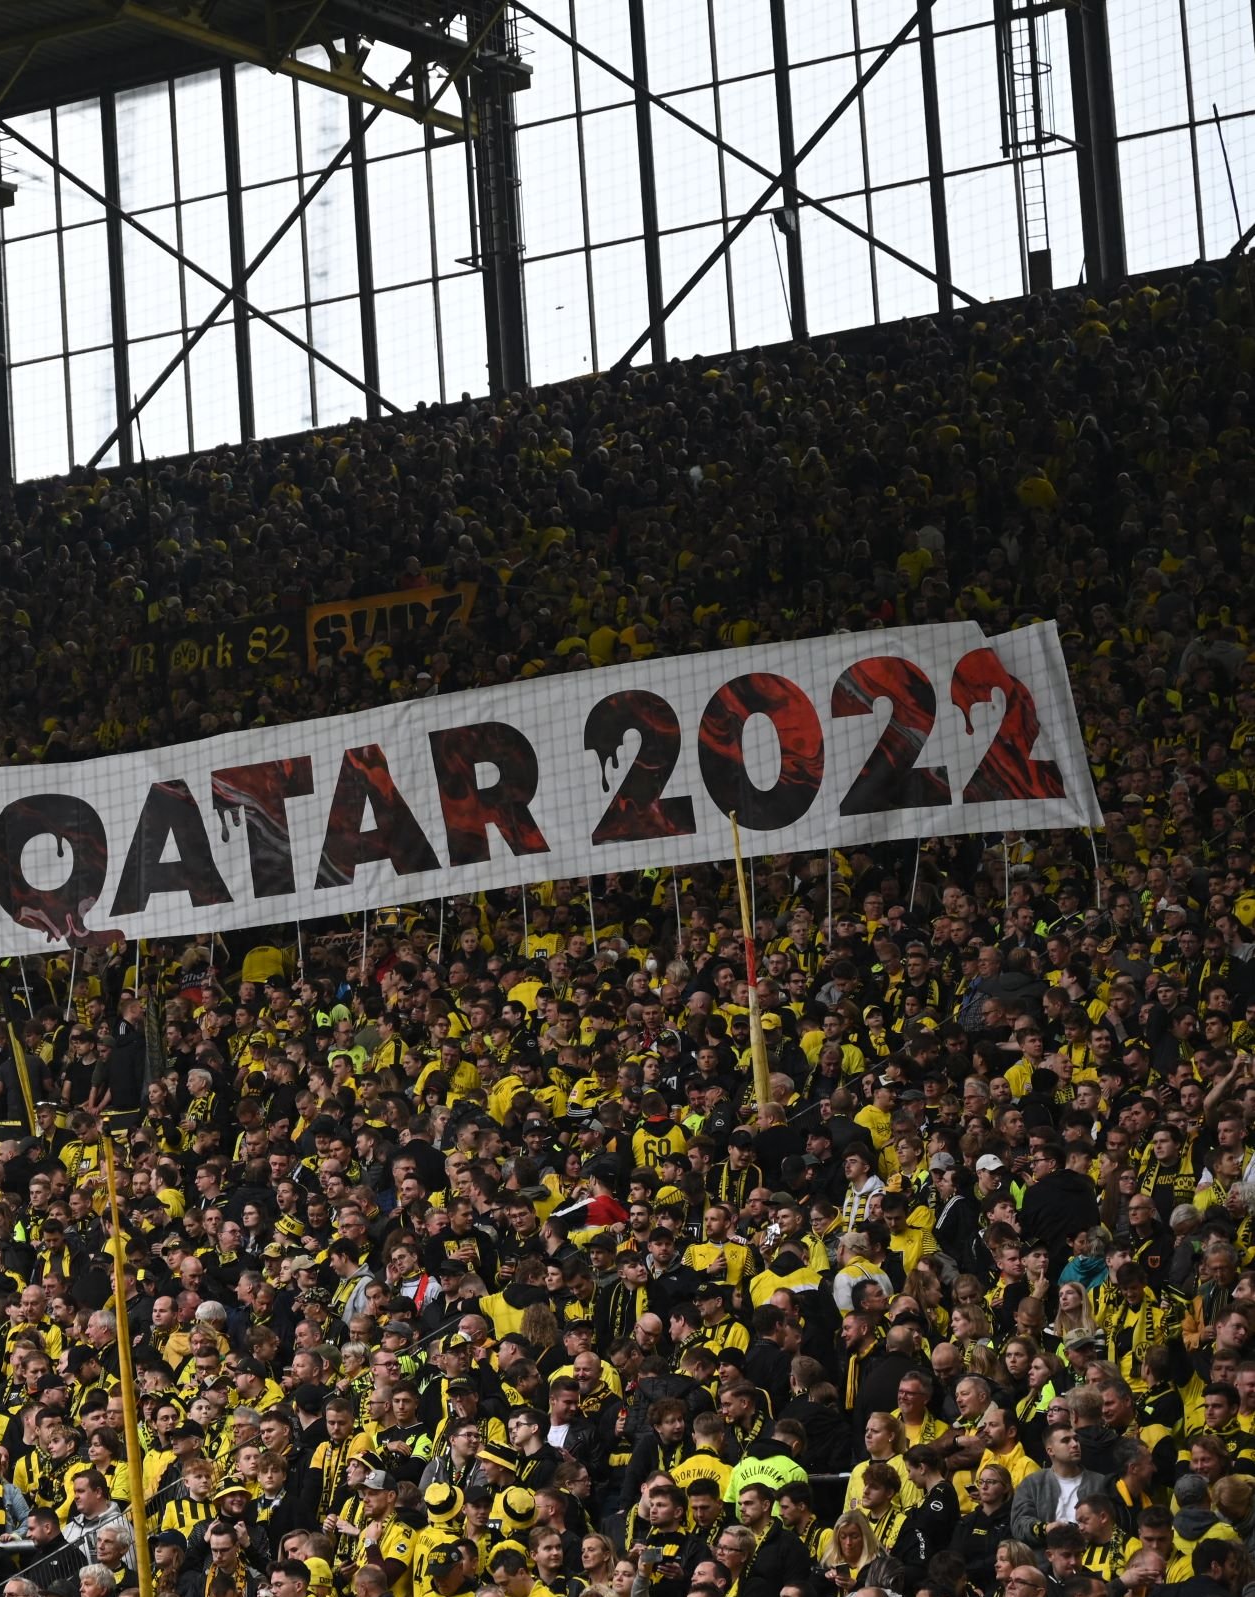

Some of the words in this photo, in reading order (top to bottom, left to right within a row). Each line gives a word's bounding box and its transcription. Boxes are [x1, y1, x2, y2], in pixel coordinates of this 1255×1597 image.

[247, 624, 291, 664] 82
[584, 647, 1066, 847] 2022
[286, 1221, 295, 1230] 09
[675, 1468, 721, 1484] DORTMUND
[741, 1465, 786, 1484] BELLINGHAM
